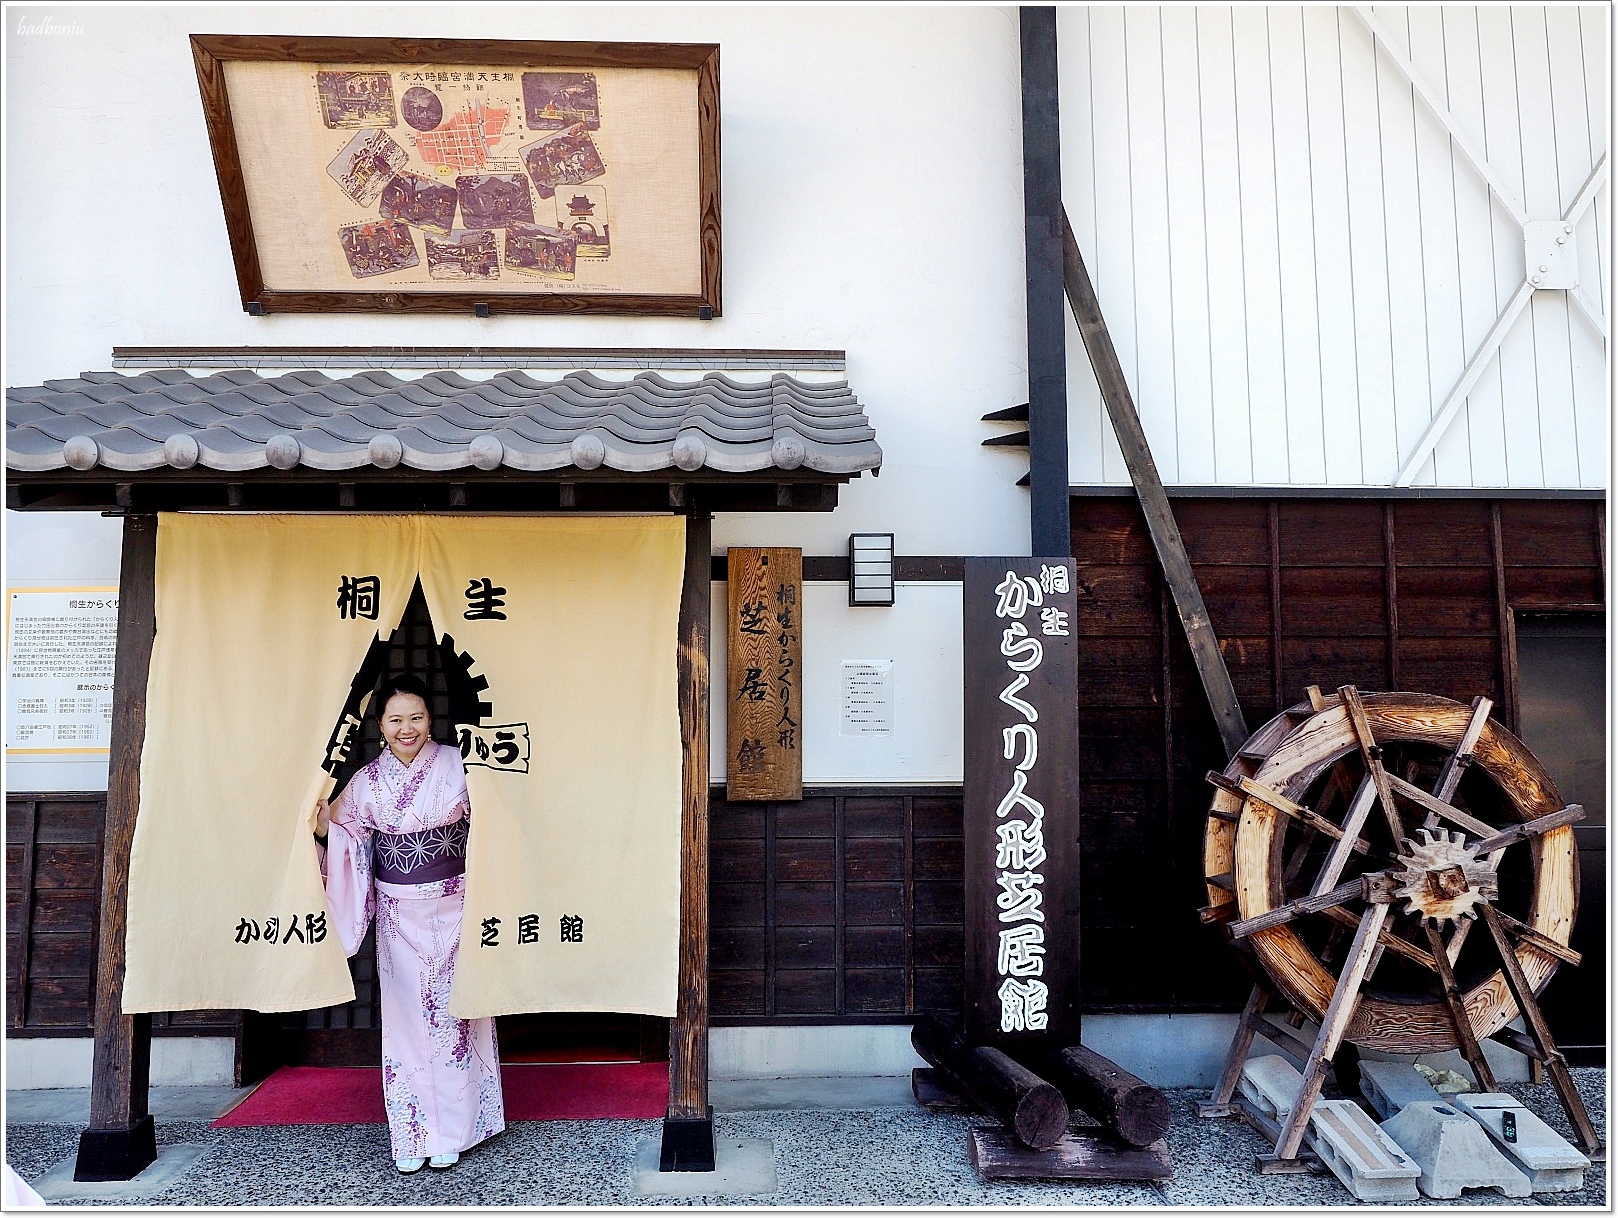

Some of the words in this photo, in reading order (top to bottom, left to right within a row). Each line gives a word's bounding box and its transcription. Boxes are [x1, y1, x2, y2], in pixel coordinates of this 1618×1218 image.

[775, 583, 799, 751] 桐生からくり人形
[1040, 563, 1071, 637] 桐生
[995, 570, 1049, 1033] からくり人形芝居館
